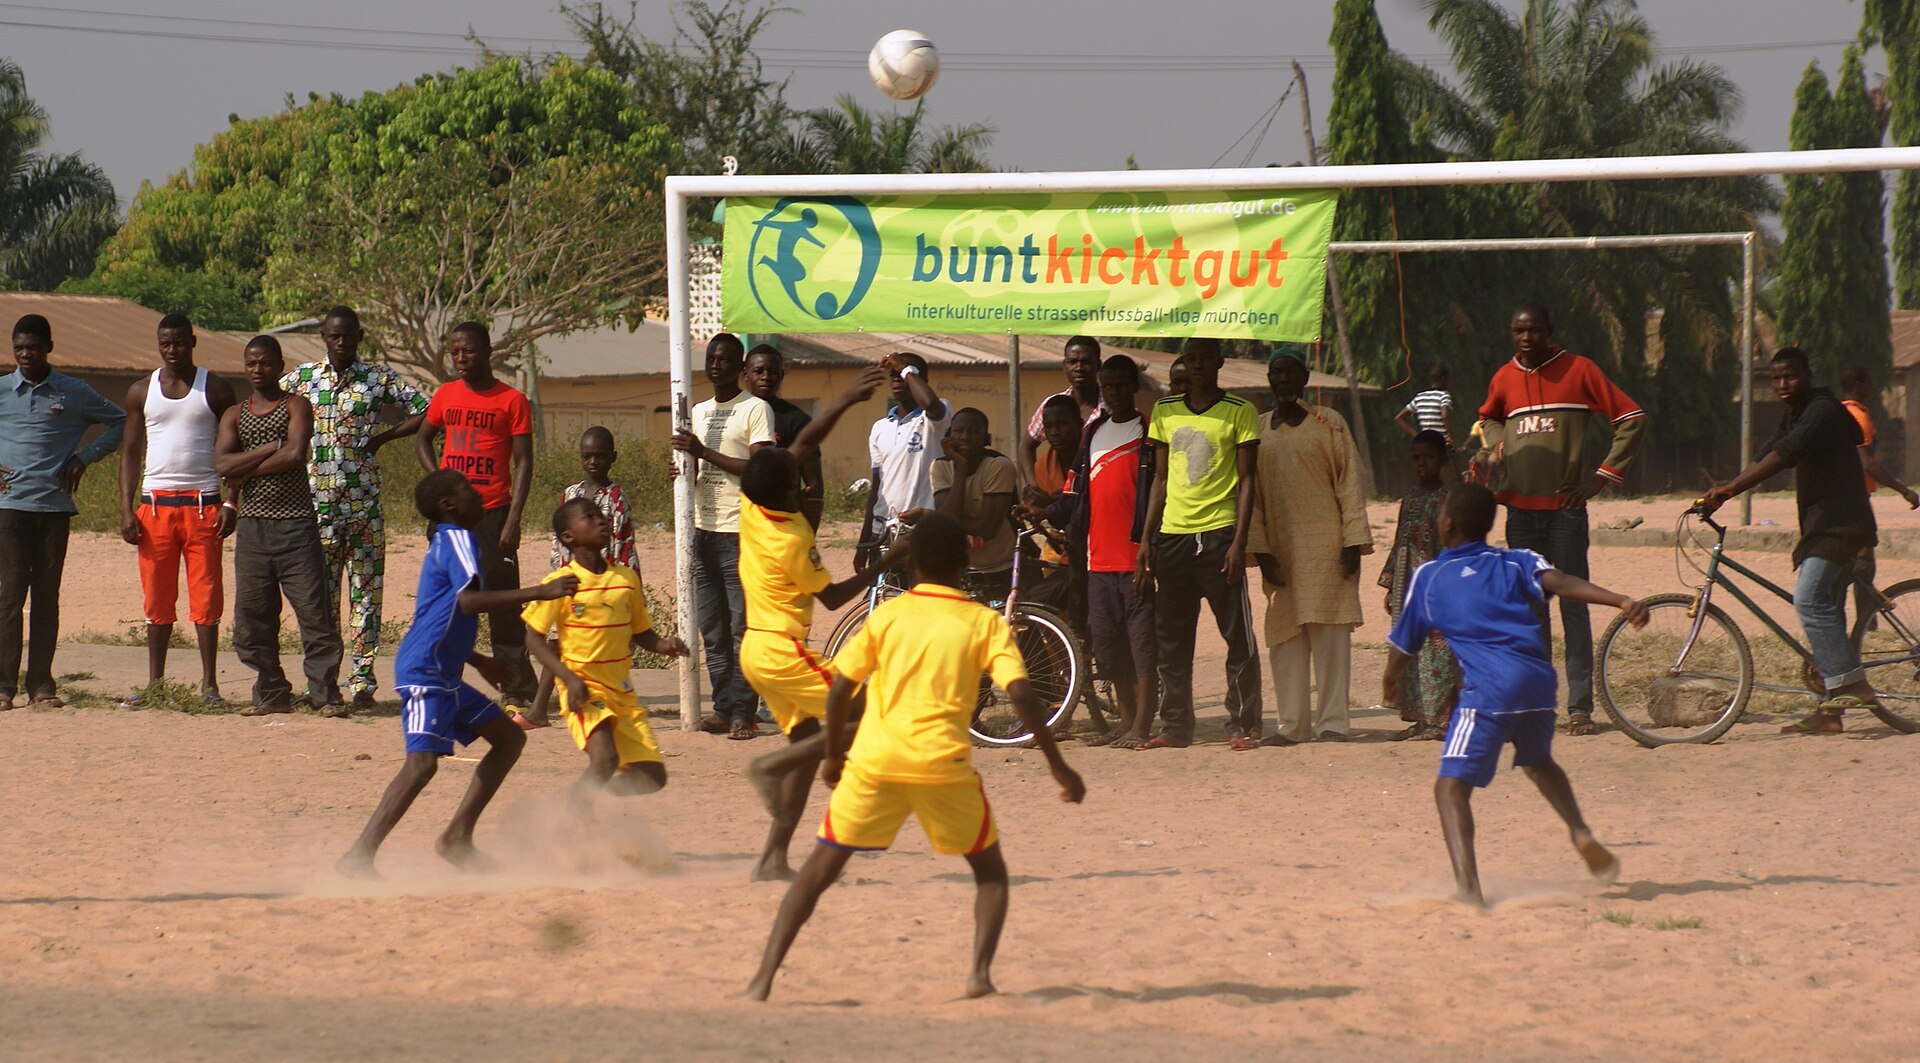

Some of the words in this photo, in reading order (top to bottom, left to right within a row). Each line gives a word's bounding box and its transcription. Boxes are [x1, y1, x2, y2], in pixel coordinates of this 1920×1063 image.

[911, 231, 1289, 300] buntkicktgut
[906, 302, 1023, 320] interkulturelle
[1027, 304, 1200, 325] strassenfussball-liga
[1203, 307, 1280, 326] münchen
[445, 408, 463, 426] QUI
[465, 409, 497, 430] PEUT
[451, 427, 486, 453] ME
[446, 454, 495, 475] STOPER
